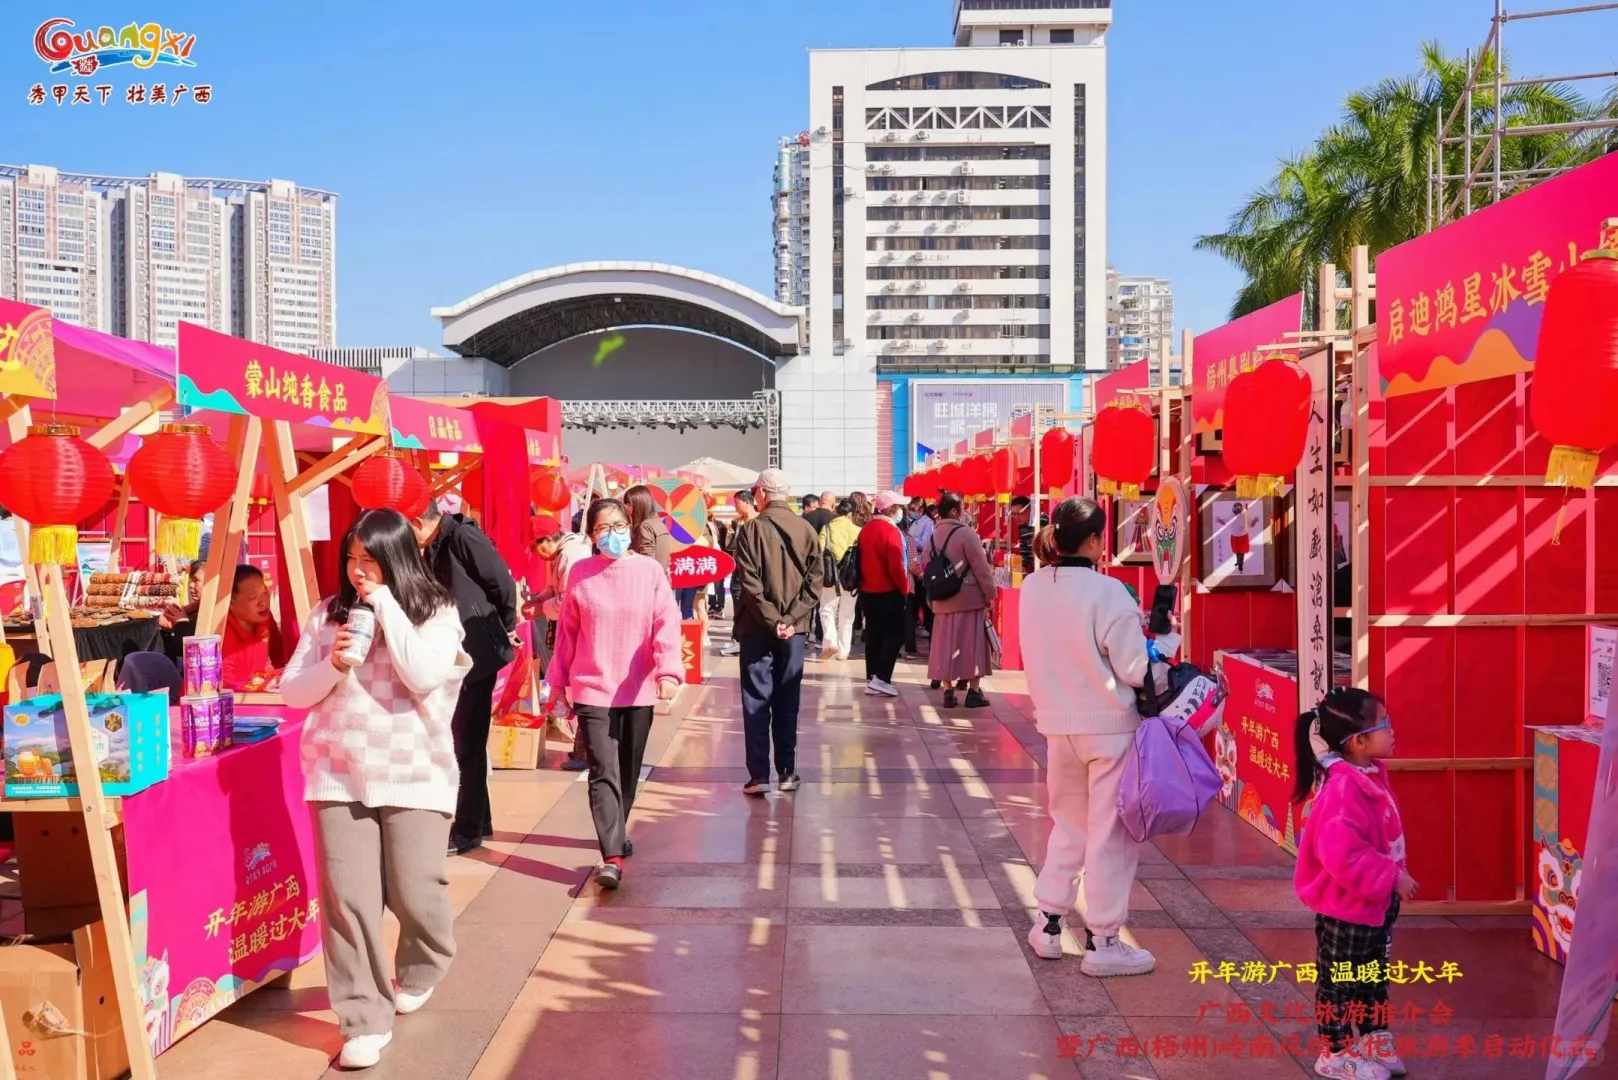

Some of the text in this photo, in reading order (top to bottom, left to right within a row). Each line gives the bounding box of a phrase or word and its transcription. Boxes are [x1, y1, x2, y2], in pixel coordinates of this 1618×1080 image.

[244, 358, 349, 415] 蒙山纯香食品
[668, 555, 718, 576] 满满
[1241, 715, 1279, 751] 开年游广西
[1249, 744, 1290, 783] 温暖过大年
[203, 874, 301, 943] 开年游广西
[228, 897, 320, 967] 温暖过大年
